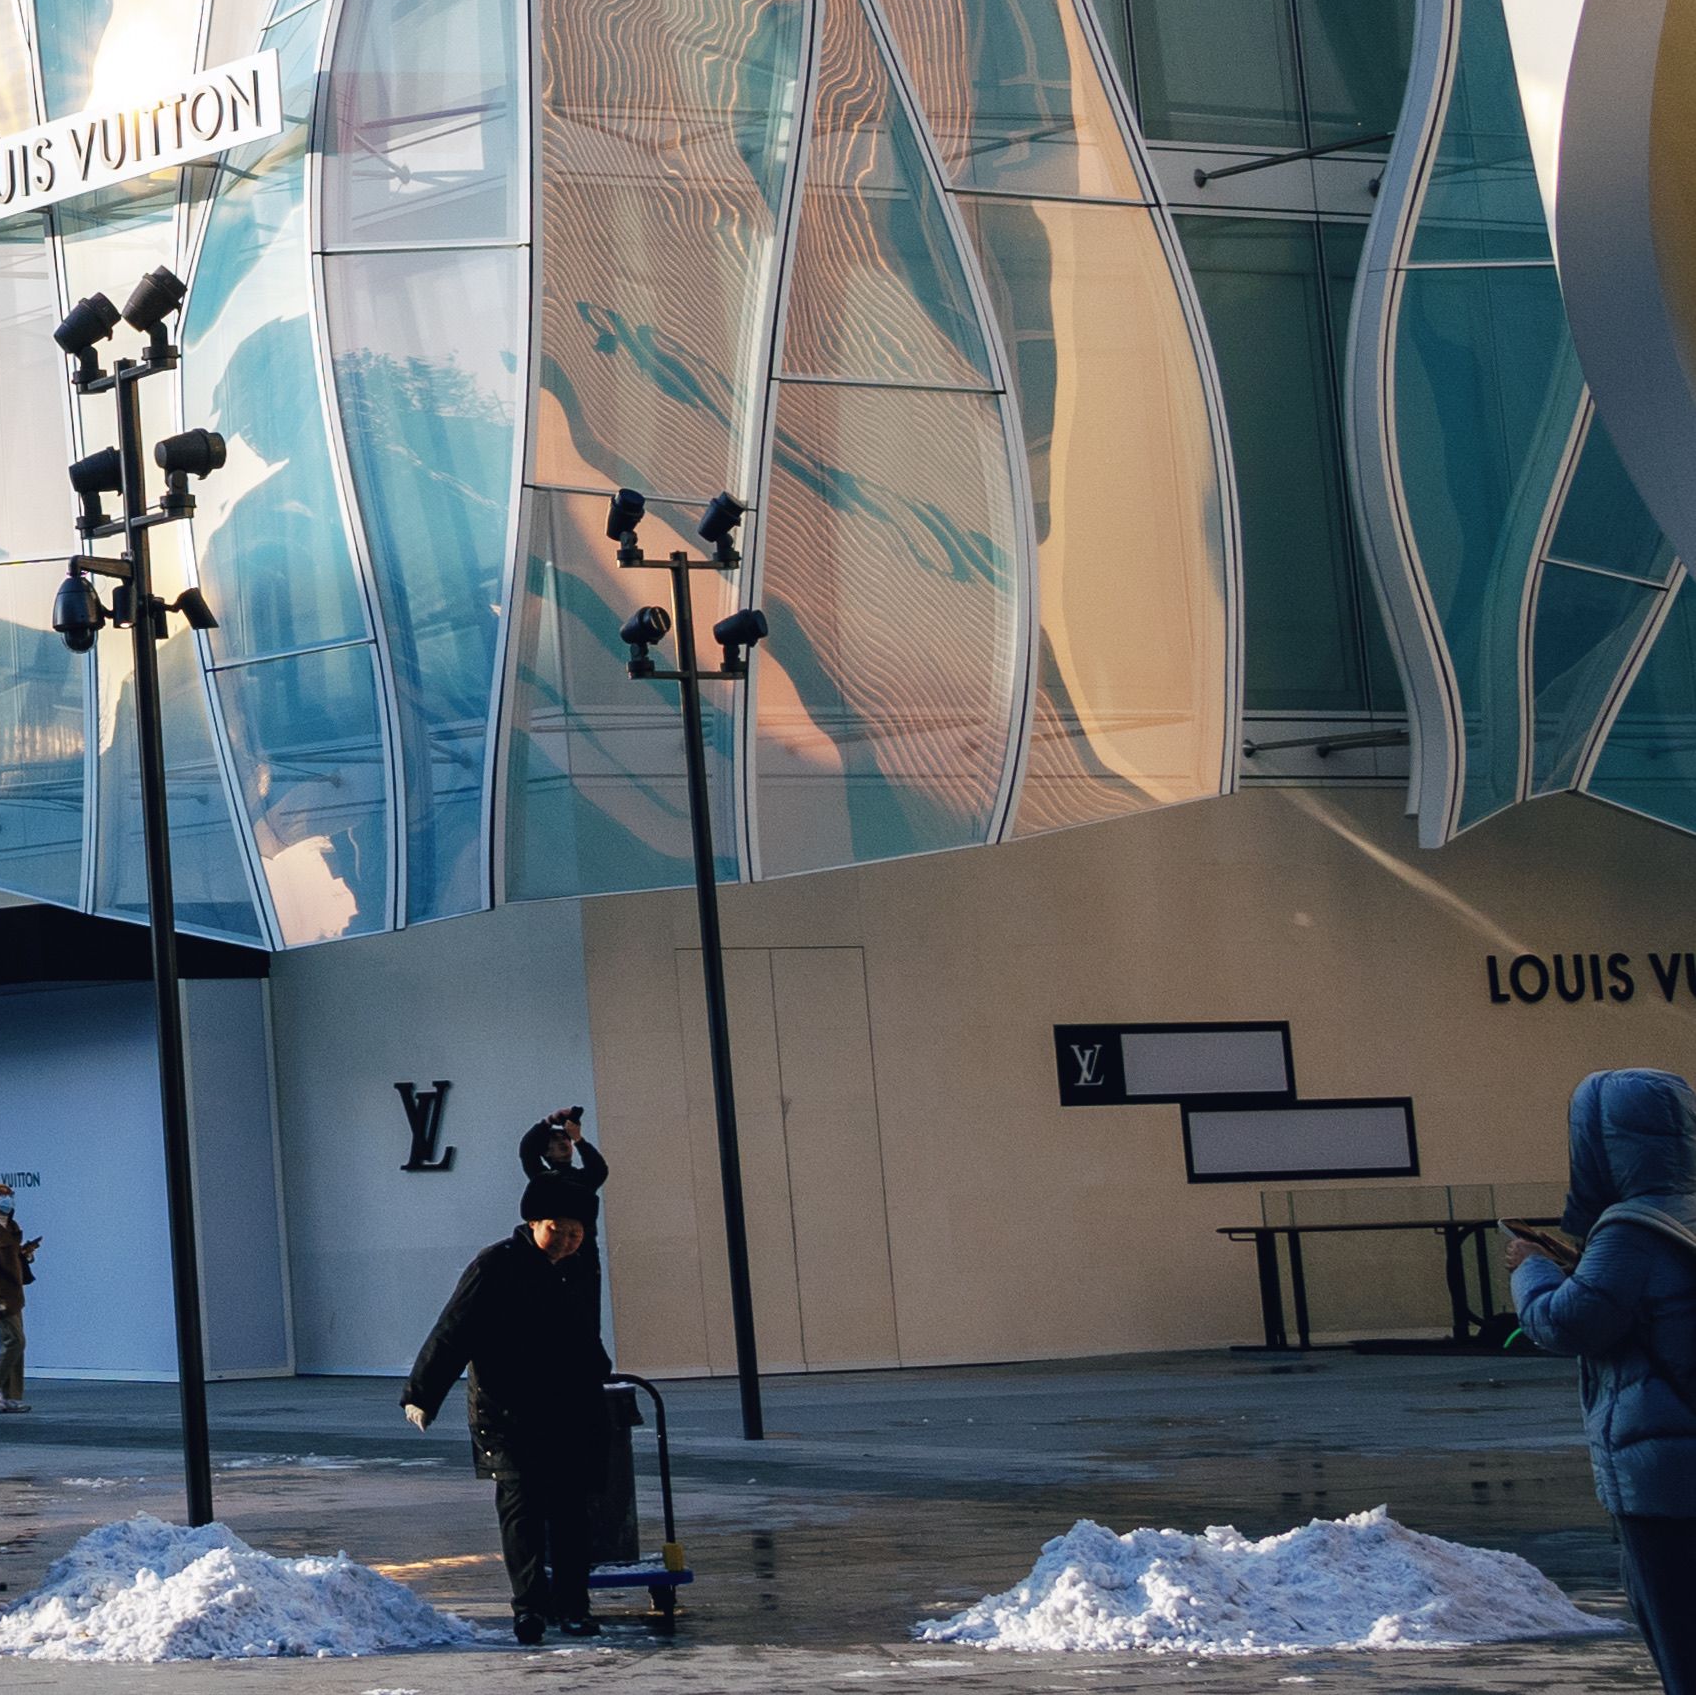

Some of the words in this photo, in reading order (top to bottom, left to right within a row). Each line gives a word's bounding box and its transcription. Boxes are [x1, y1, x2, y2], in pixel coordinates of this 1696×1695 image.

[67, 69, 263, 181] VUITTON
[1486, 952, 1635, 1003] LOUIS
[1, 1171, 41, 1188] VUITTON
